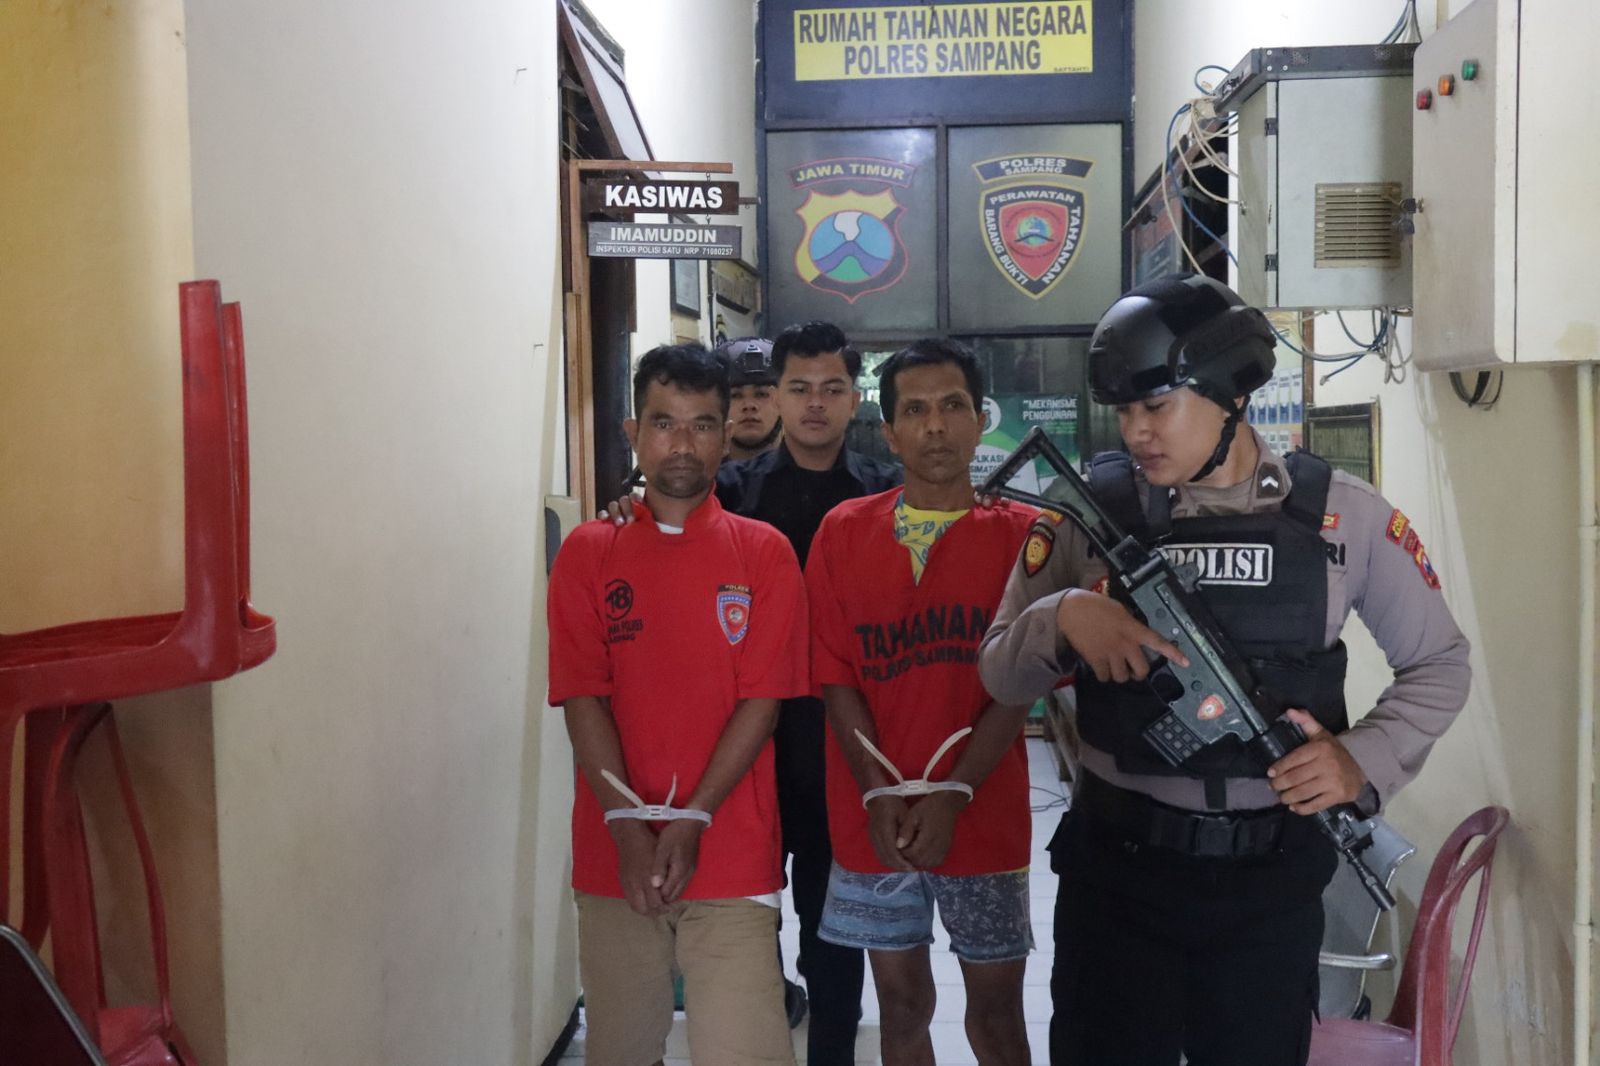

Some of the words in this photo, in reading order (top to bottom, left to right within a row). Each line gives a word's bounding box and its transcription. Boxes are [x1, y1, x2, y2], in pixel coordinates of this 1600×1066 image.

[799, 11, 876, 44] RUMAH
[884, 7, 989, 42] TAHANAN
[995, 4, 1088, 36] NEGARA
[844, 43, 928, 75] POLRES
[936, 40, 1041, 73] SAMPANG
[796, 163, 844, 182] JAWA
[849, 163, 905, 180] TIMUR
[1000, 158, 1067, 170] POLRES
[1004, 166, 1063, 176] SAMPANG
[604, 184, 723, 209] KASIWAS
[989, 190, 1076, 205] PERAWATAN
[611, 227, 718, 243] IMAMUDDIN
[1037, 205, 1081, 285] TAHANAN
[595, 245, 636, 254] INSPEKTUR
[638, 245, 661, 254] POLISI
[662, 246, 681, 255] SATU
[684, 247, 699, 255] NRP
[984, 208, 1006, 254] BARANG
[999, 254, 1029, 286] BUKTI
[855, 604, 992, 660] TAHANAN
